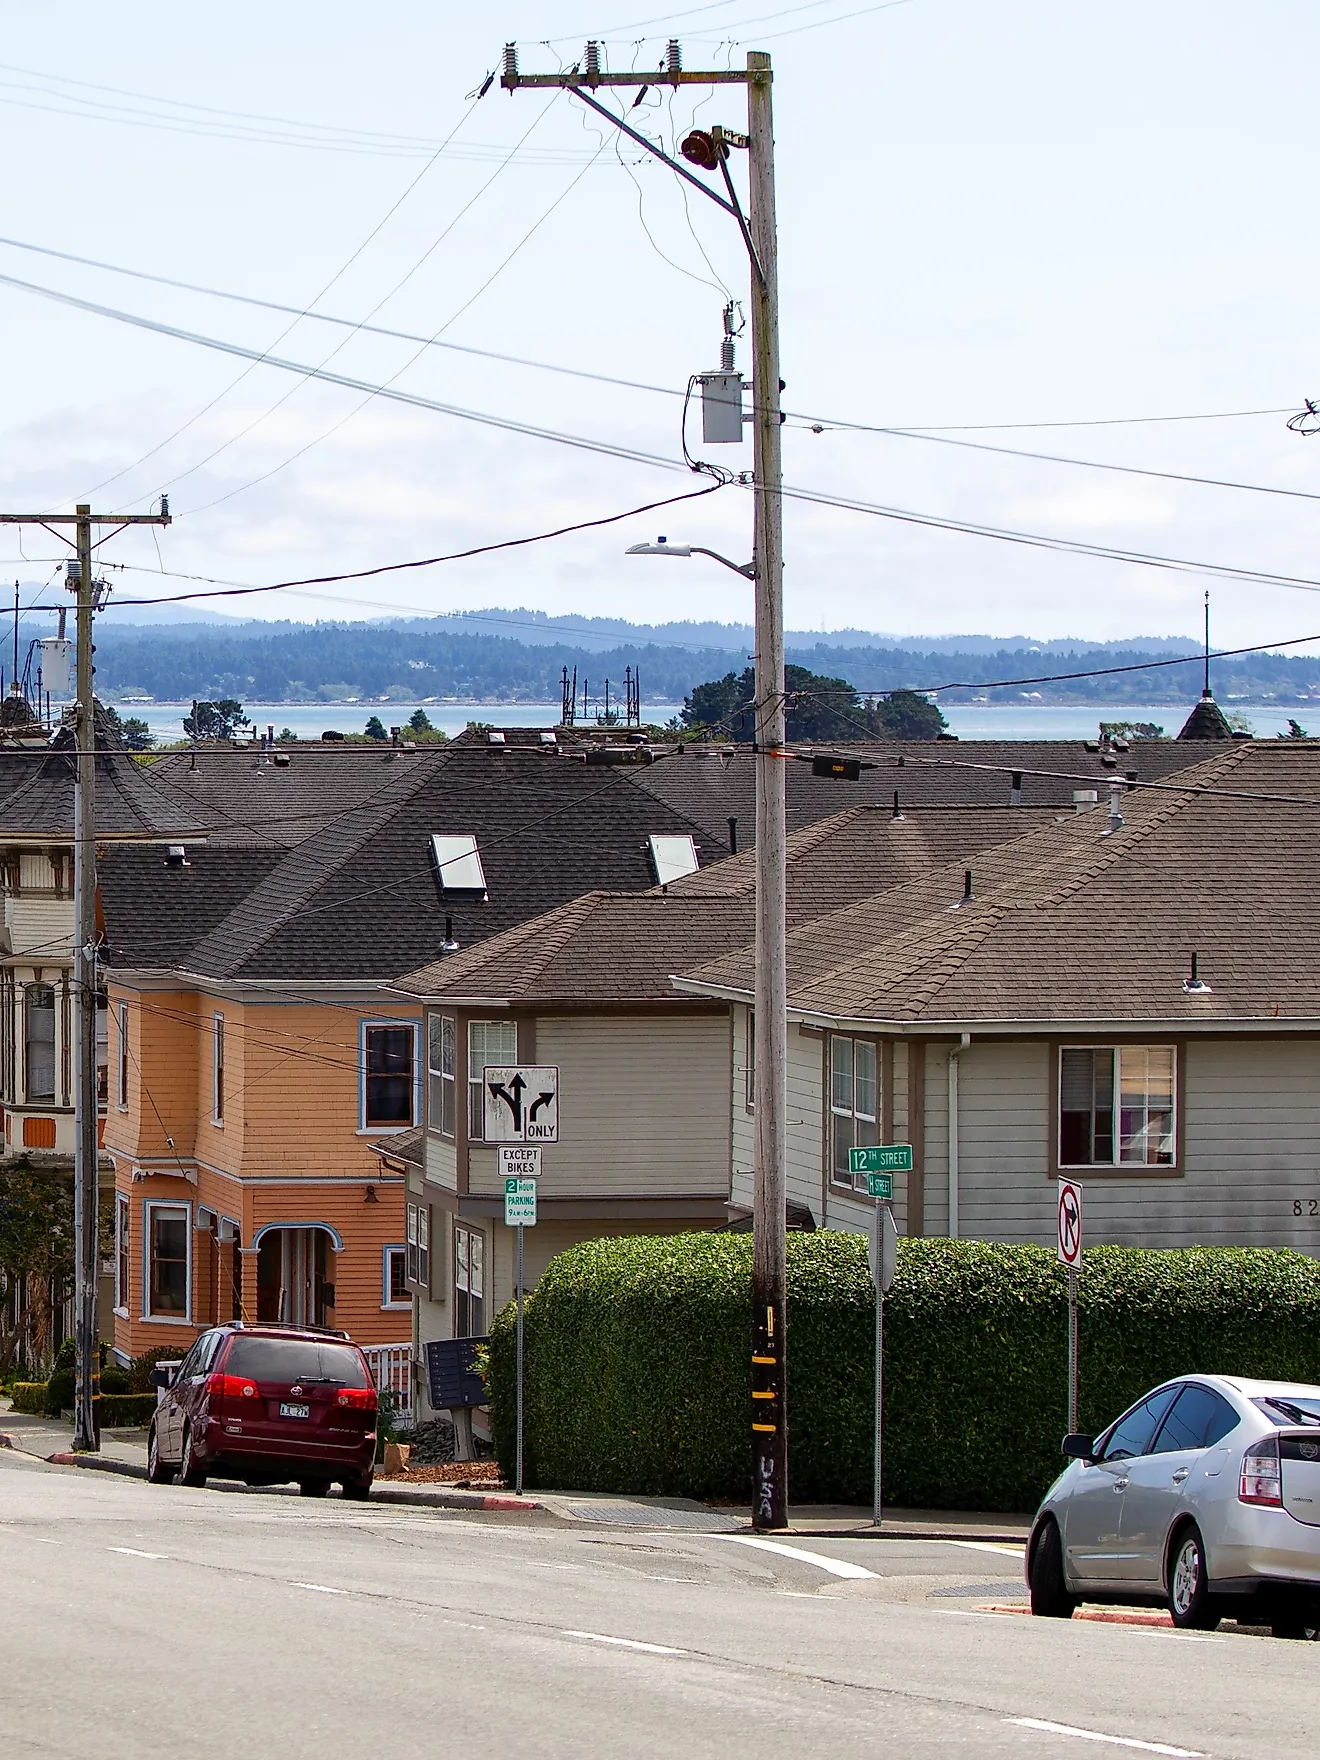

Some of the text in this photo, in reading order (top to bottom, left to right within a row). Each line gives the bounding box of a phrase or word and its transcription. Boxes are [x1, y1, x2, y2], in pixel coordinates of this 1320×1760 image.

[528, 1125, 555, 1137] ONLY
[503, 1150, 538, 1160] EXCEPT
[880, 1151, 907, 1165] STREET
[507, 1162, 535, 1173] BIKES
[507, 1180, 534, 1191] 2 HOUR
[869, 1176, 890, 1193] H STREET
[507, 1196, 535, 1206] PARKING
